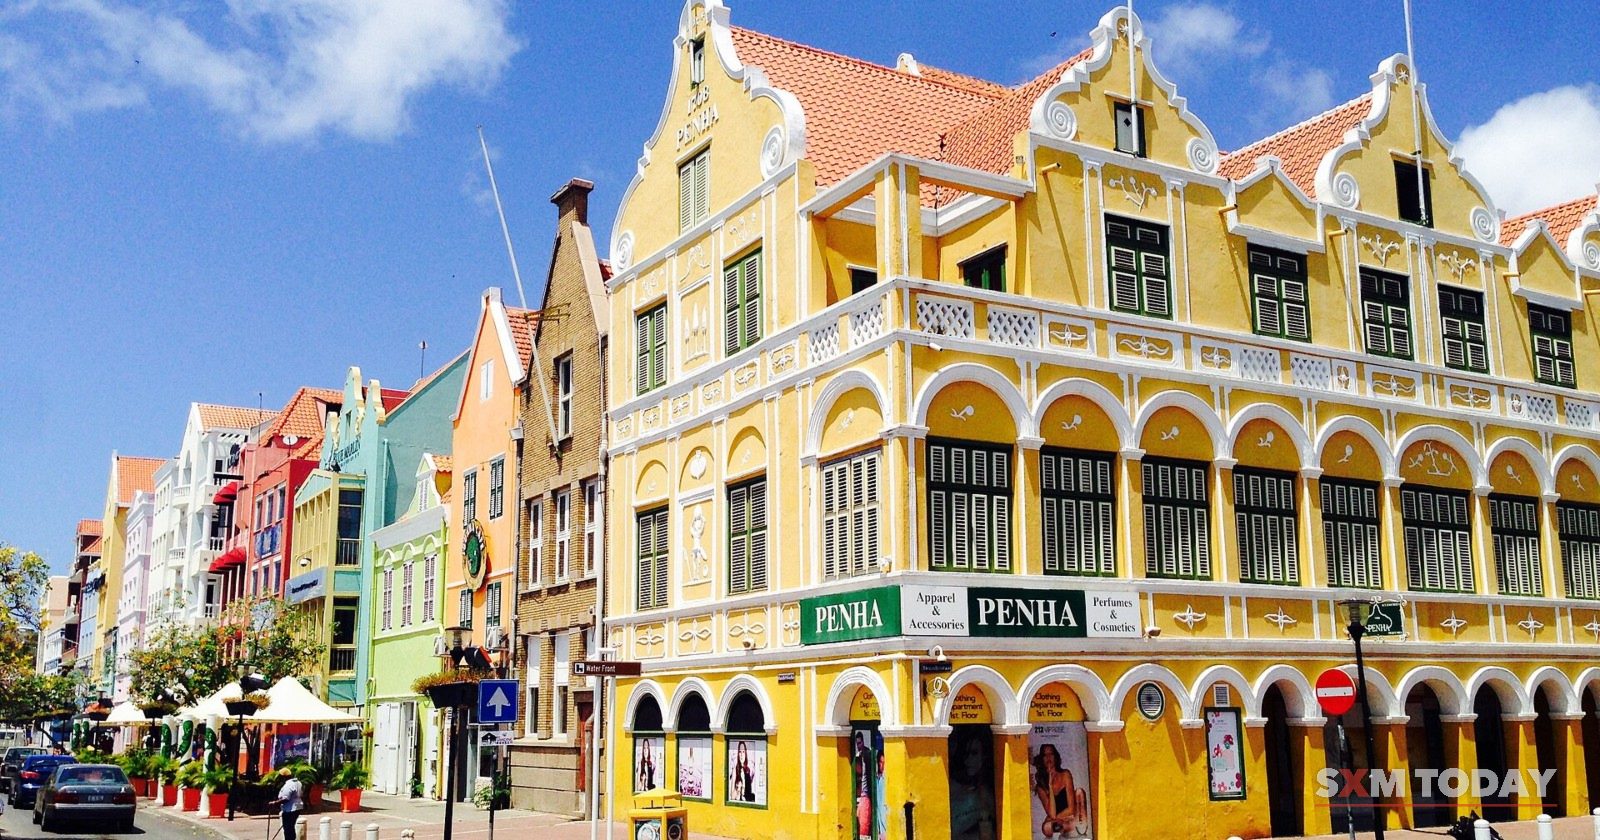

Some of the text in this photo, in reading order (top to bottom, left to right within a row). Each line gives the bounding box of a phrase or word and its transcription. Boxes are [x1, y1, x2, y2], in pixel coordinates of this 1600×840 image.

[677, 103, 718, 151] PENHA
[916, 592, 955, 604] Apparel
[1093, 597, 1133, 608] Perfumes
[931, 606, 941, 616] &
[976, 598, 1078, 627] PENHA
[1109, 610, 1118, 619] &
[815, 599, 883, 634] PENHA
[909, 619, 965, 630] Accessories
[1093, 621, 1136, 632] Cosmetics
[1367, 624, 1391, 632] PENHA
[586, 664, 616, 672] Water Front
[1035, 692, 1061, 702] Clothing
[1030, 701, 1067, 710] Department
[961, 711, 978, 719] Floor
